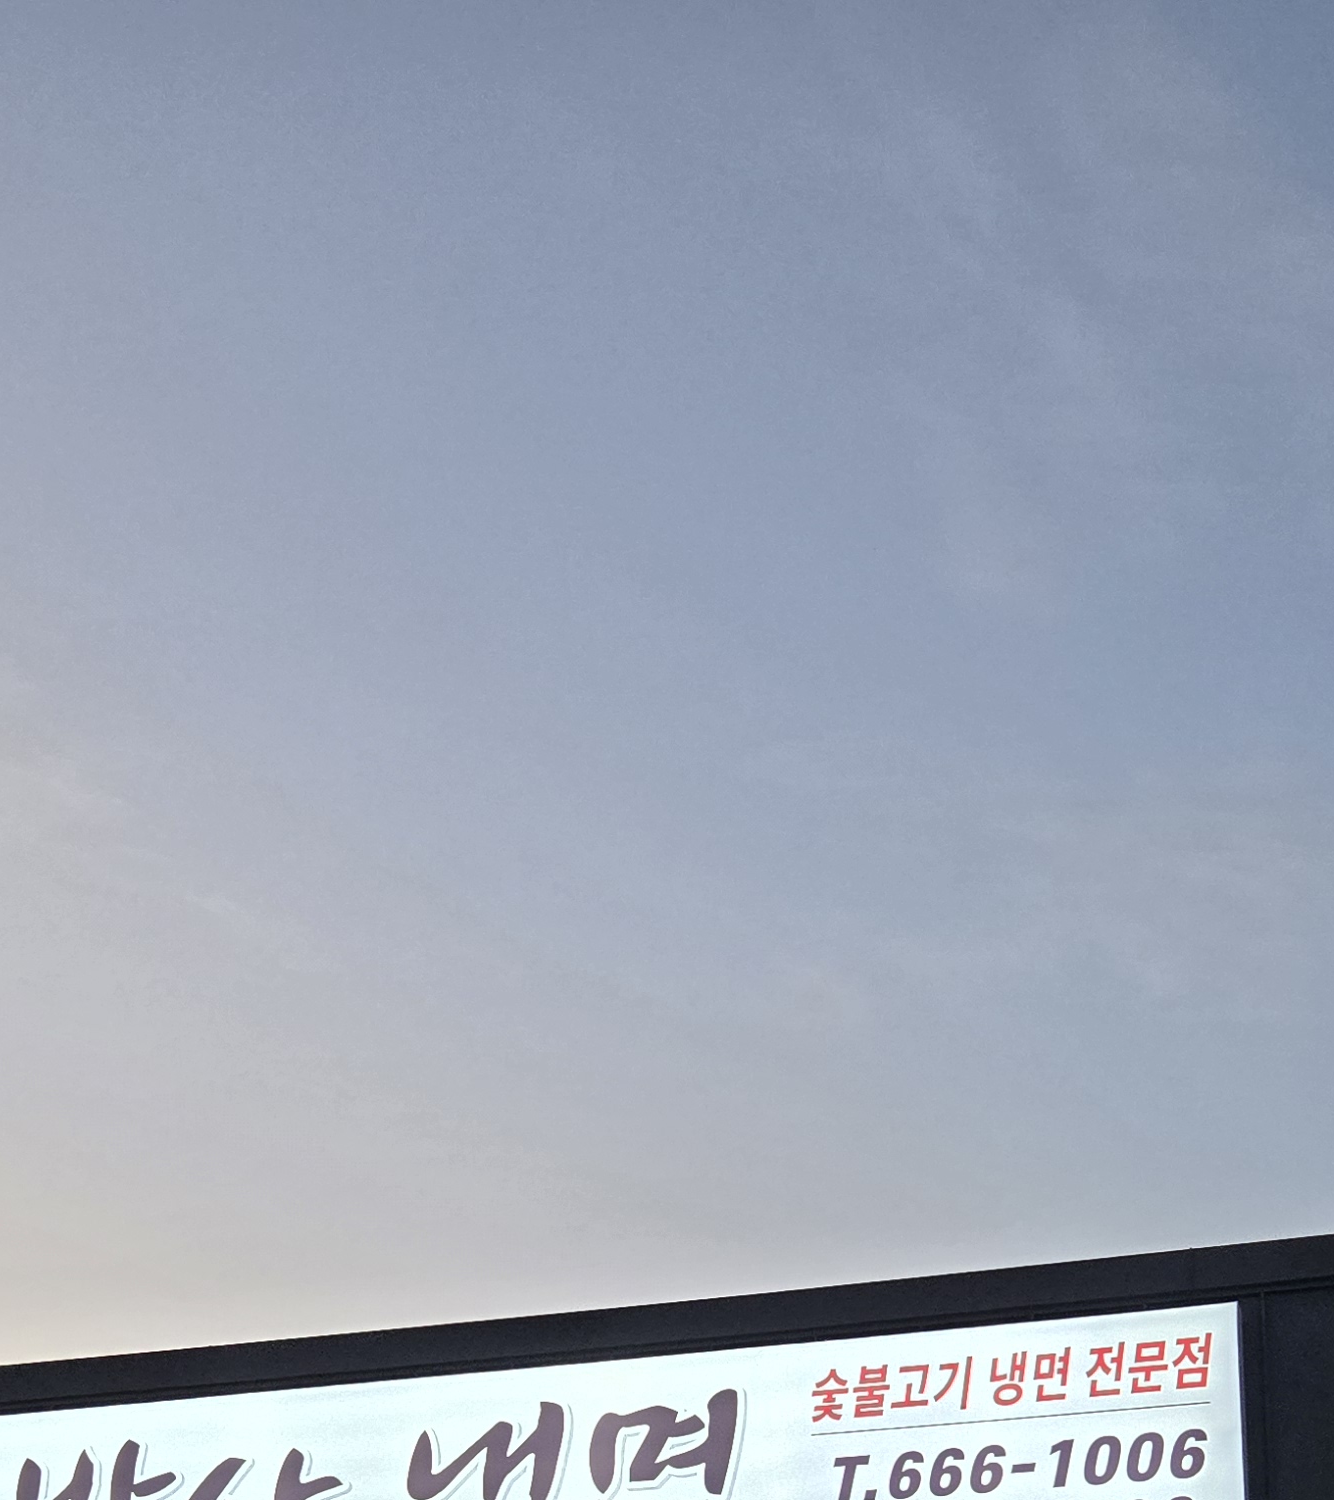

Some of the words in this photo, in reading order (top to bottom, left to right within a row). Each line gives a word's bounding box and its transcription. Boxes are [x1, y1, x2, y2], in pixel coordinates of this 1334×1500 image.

[811, 1356, 973, 1423] 숯불고기
[990, 1346, 1072, 1408] 냉면
[1085, 1332, 1214, 1399] 전문점
